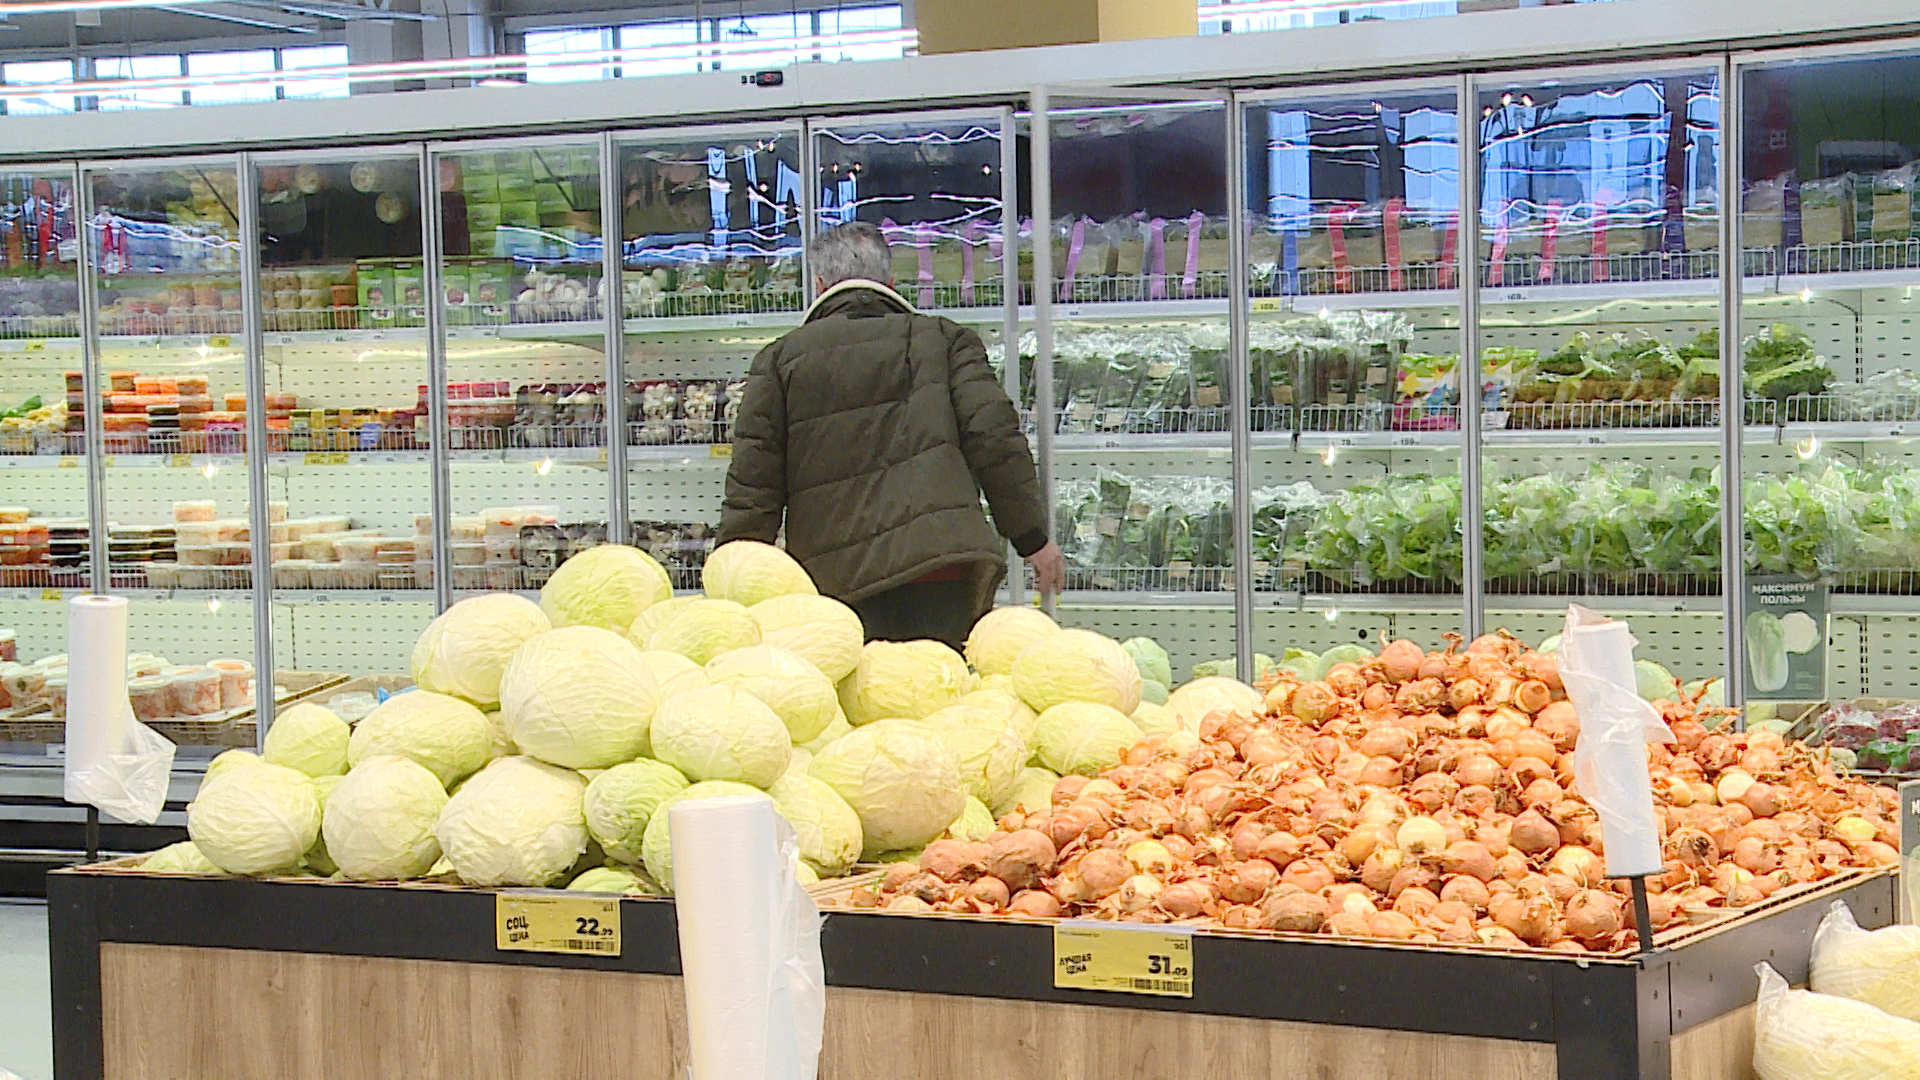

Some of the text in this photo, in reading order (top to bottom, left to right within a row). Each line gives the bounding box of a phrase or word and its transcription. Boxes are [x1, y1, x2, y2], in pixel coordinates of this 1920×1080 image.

[1752, 583, 1815, 594] МАКСИМУМ
[1760, 595, 1806, 604] ПОЛЬЗЫ
[506, 915, 530, 931] СОЦ
